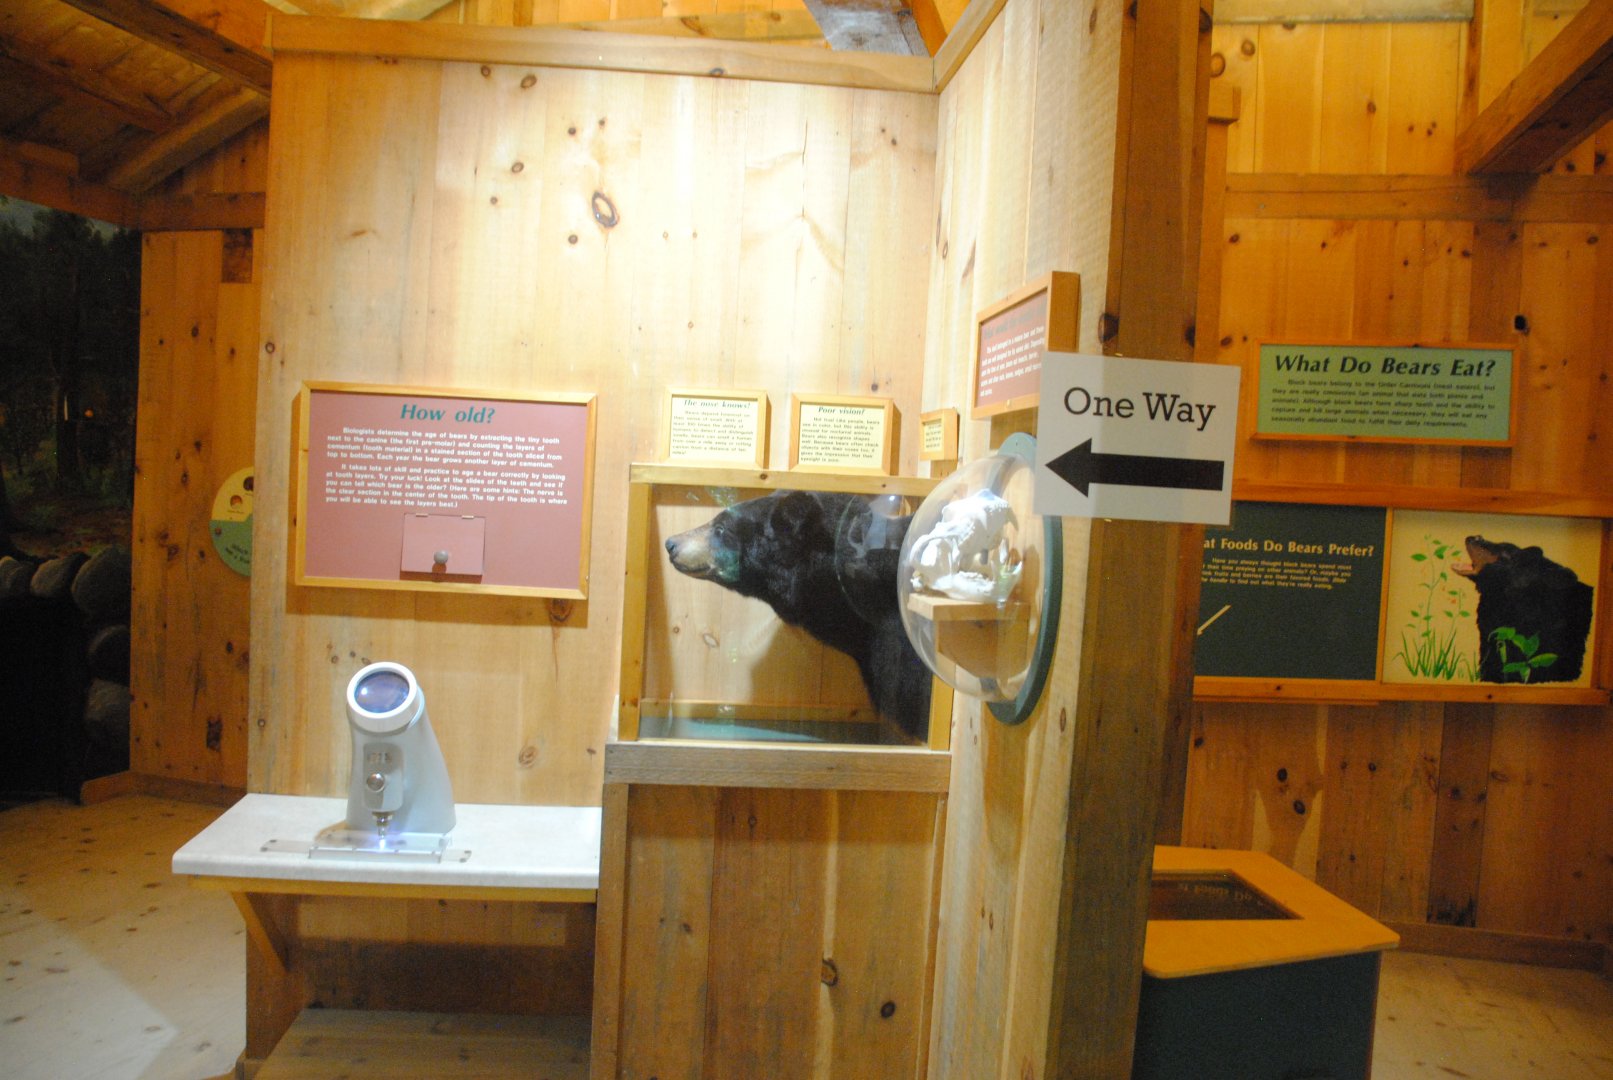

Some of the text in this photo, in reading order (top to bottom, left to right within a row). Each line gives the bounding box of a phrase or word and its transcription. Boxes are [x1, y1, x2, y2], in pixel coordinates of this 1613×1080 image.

[1276, 354, 1496, 376] What Do Bears Eat?
[401, 404, 495, 423] How old?
[1064, 387, 1216, 431] One Way
[363, 444, 382, 453] (tooth
[473, 442, 500, 450] counting
[516, 443, 534, 452] layers
[492, 459, 506, 467] layer
[355, 472, 375, 480] layers.
[424, 467, 449, 475] practice
[542, 472, 565, 480] looking
[450, 485, 466, 493] (Here
[417, 499, 436, 508] layers
[439, 500, 457, 508] best.)
[1203, 538, 1374, 557] at Foods Do Bears Prefer?
